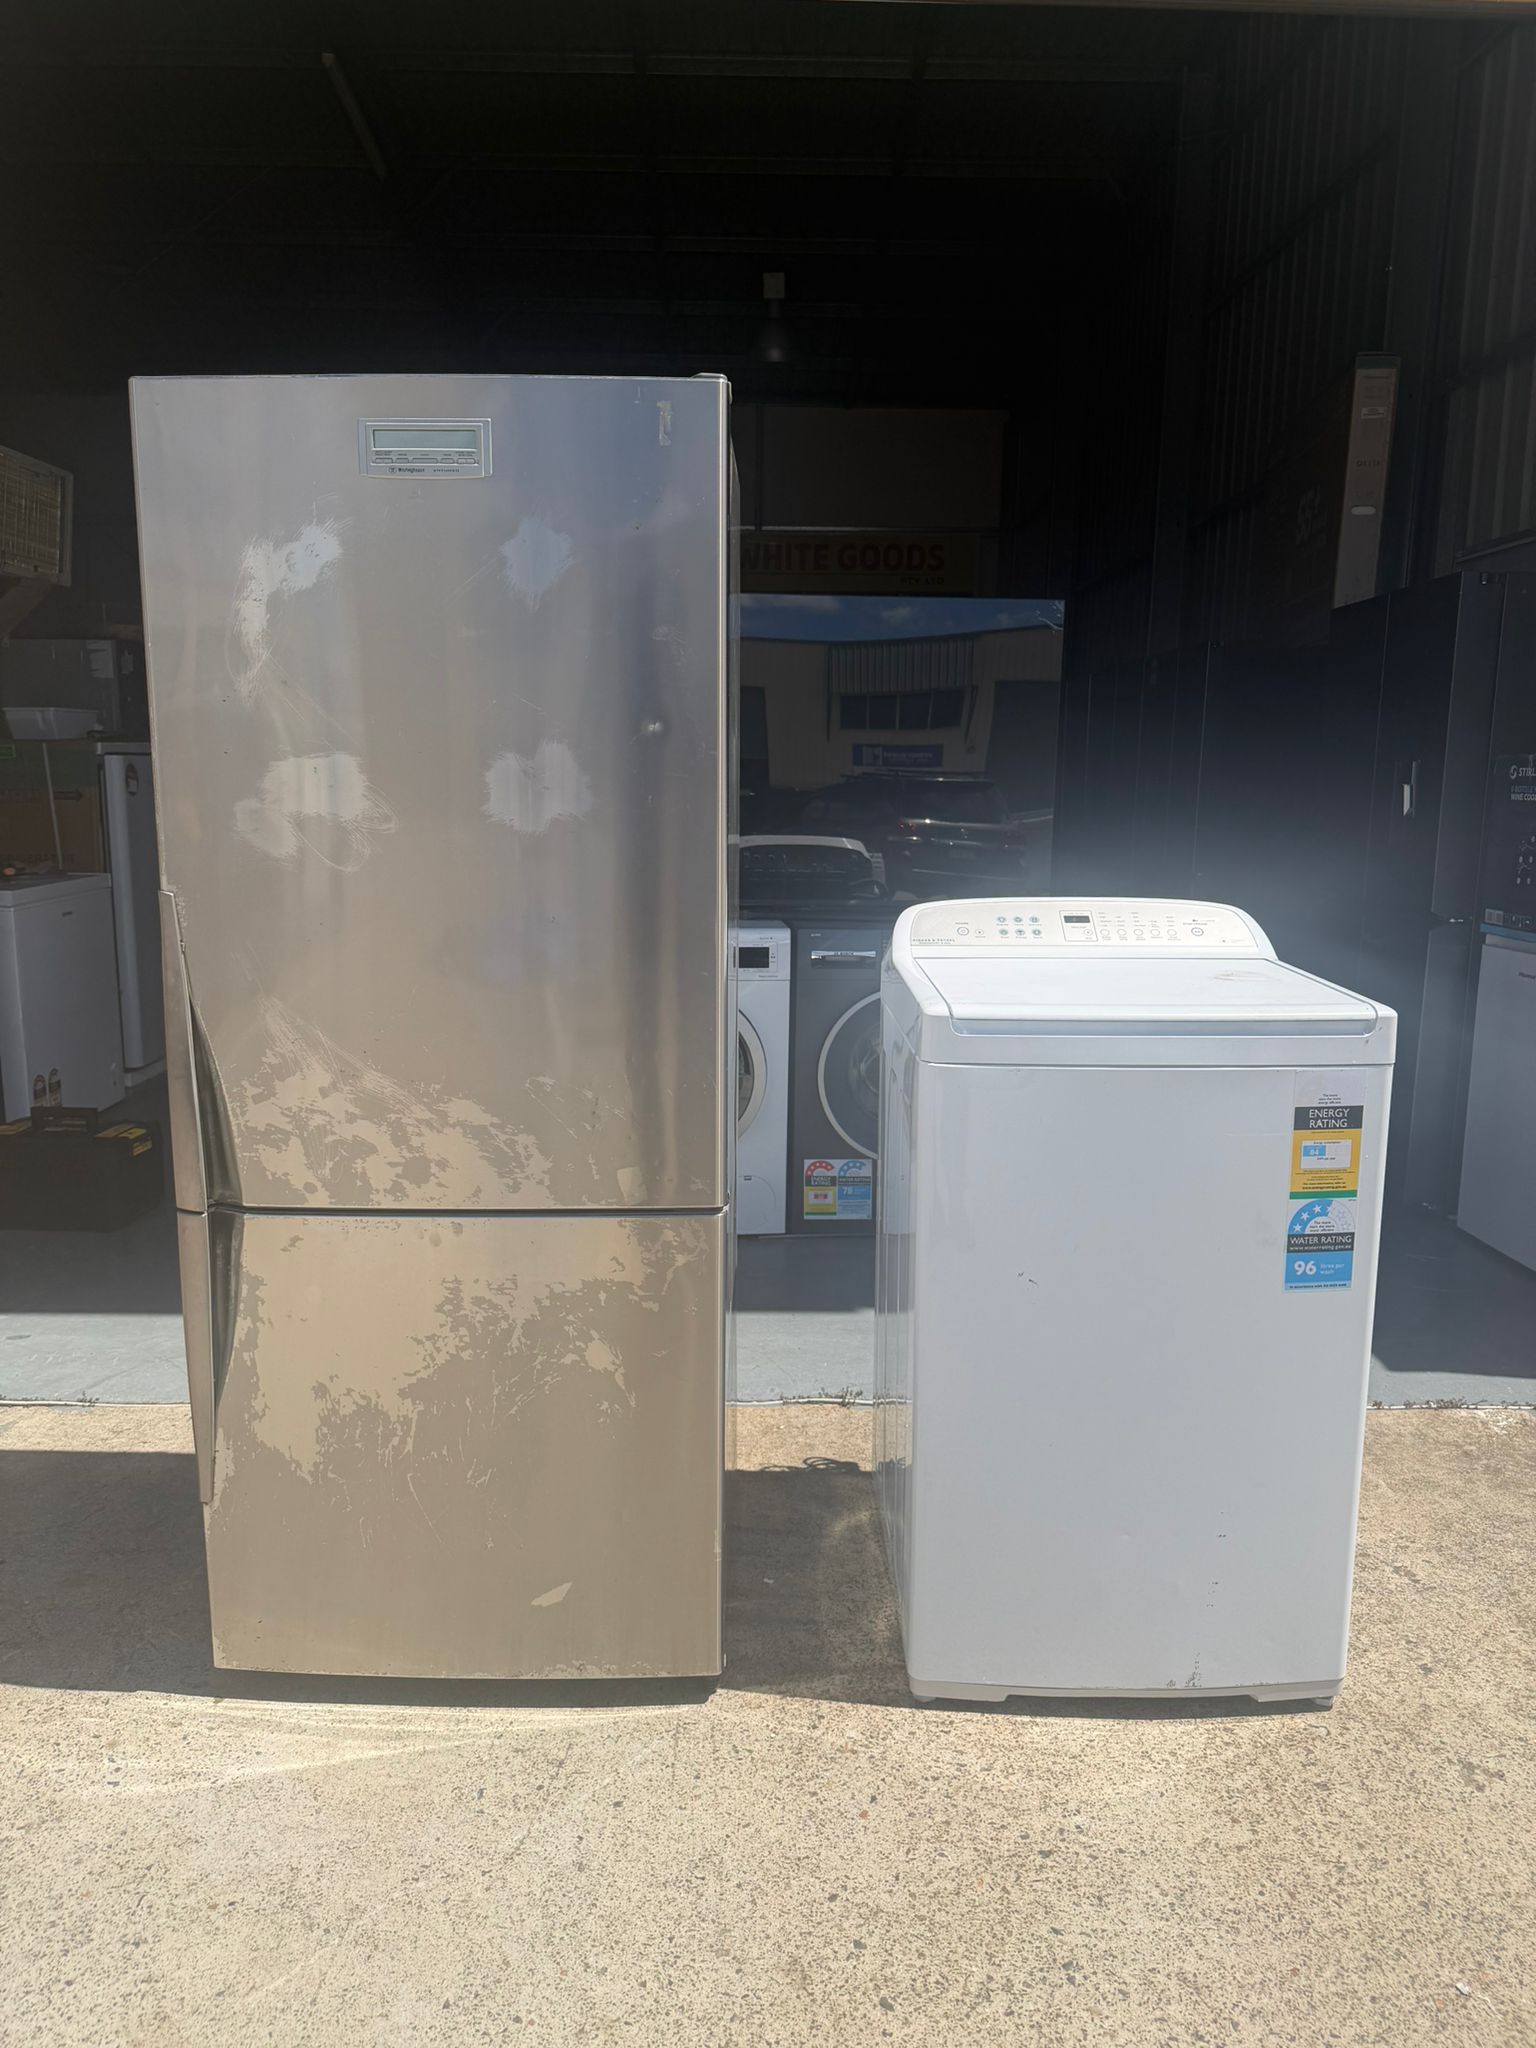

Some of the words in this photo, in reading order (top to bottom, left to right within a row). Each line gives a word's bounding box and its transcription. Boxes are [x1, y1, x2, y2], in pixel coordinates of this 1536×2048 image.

[740, 543, 829, 570] WHITE
[838, 543, 944, 570] GOODS
[1309, 1109, 1350, 1118] ENERGY
[1309, 1119, 1348, 1128] RATING
[1294, 1261, 1317, 1275] 96
